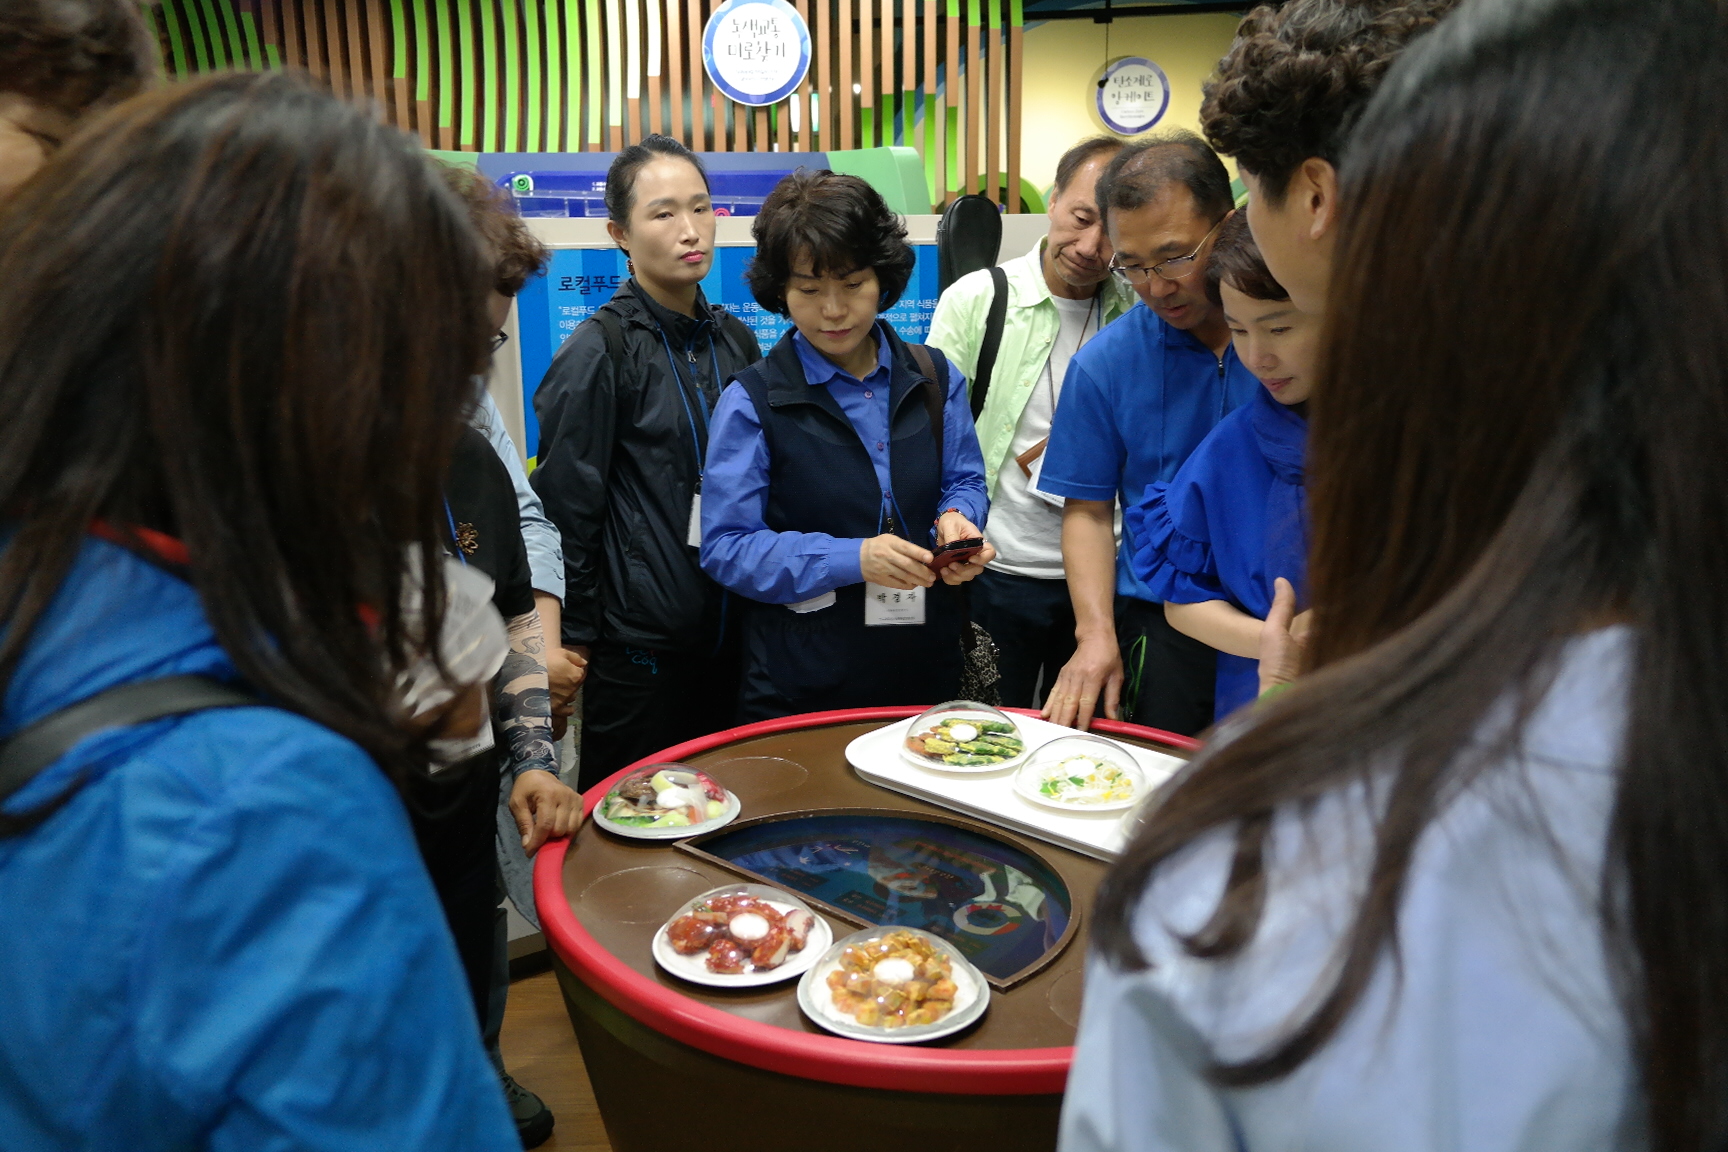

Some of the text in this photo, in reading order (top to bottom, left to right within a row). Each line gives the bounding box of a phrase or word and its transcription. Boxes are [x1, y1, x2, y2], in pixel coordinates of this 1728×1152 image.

[731, 17, 781, 39] 녹색교통
[727, 41, 785, 62] 미로찾기
[1113, 74, 1154, 88] 탄소제로
[558, 275, 622, 295] 로컬푸드
[899, 299, 915, 309] 지역
